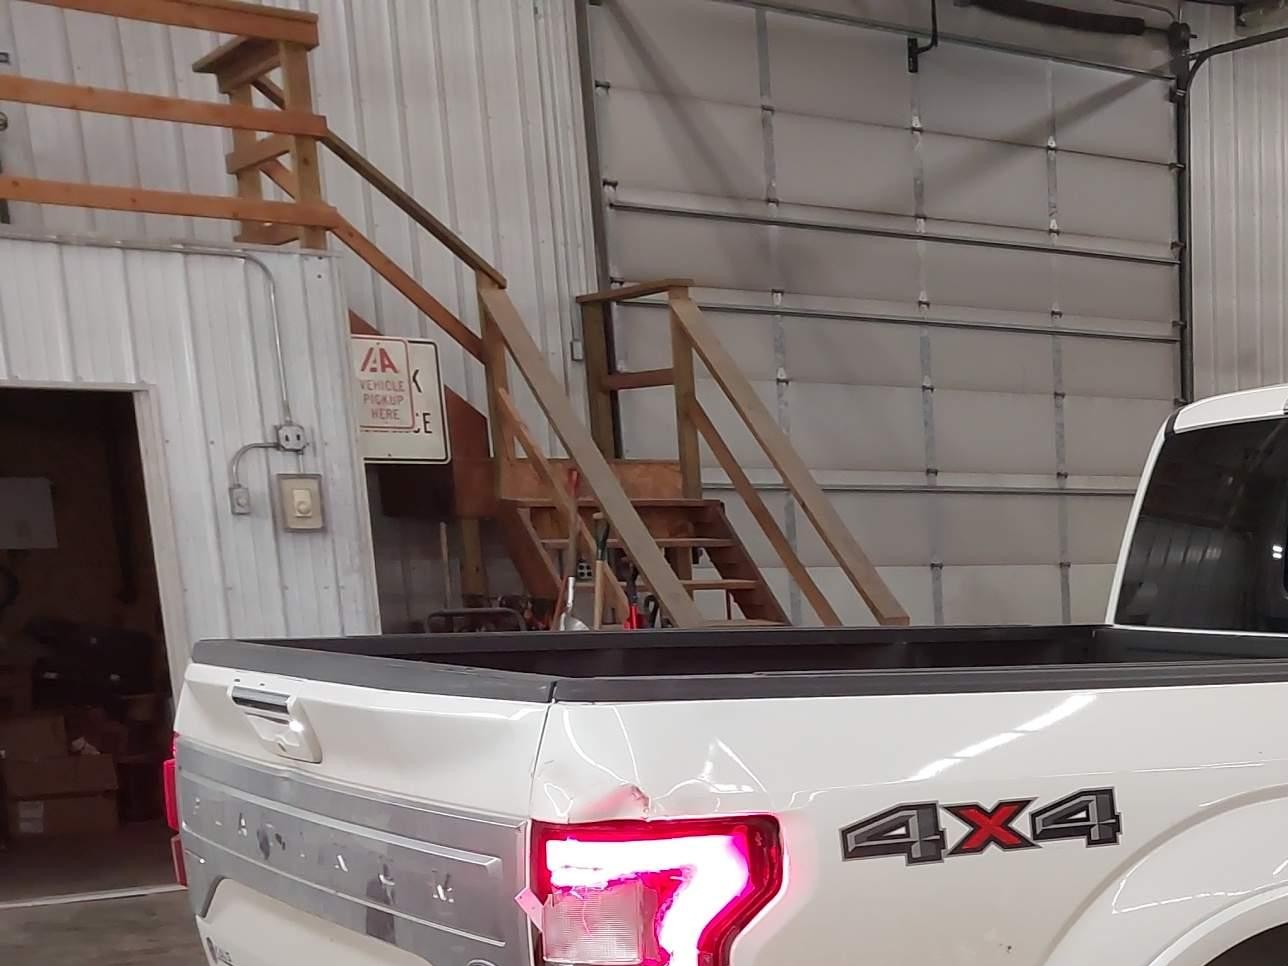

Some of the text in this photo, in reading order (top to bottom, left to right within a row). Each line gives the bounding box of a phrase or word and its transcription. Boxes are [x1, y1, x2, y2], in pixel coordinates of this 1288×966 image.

[361, 380, 405, 392] VEHICLE
[363, 393, 404, 405] PICKUP
[371, 408, 400, 420] HERE
